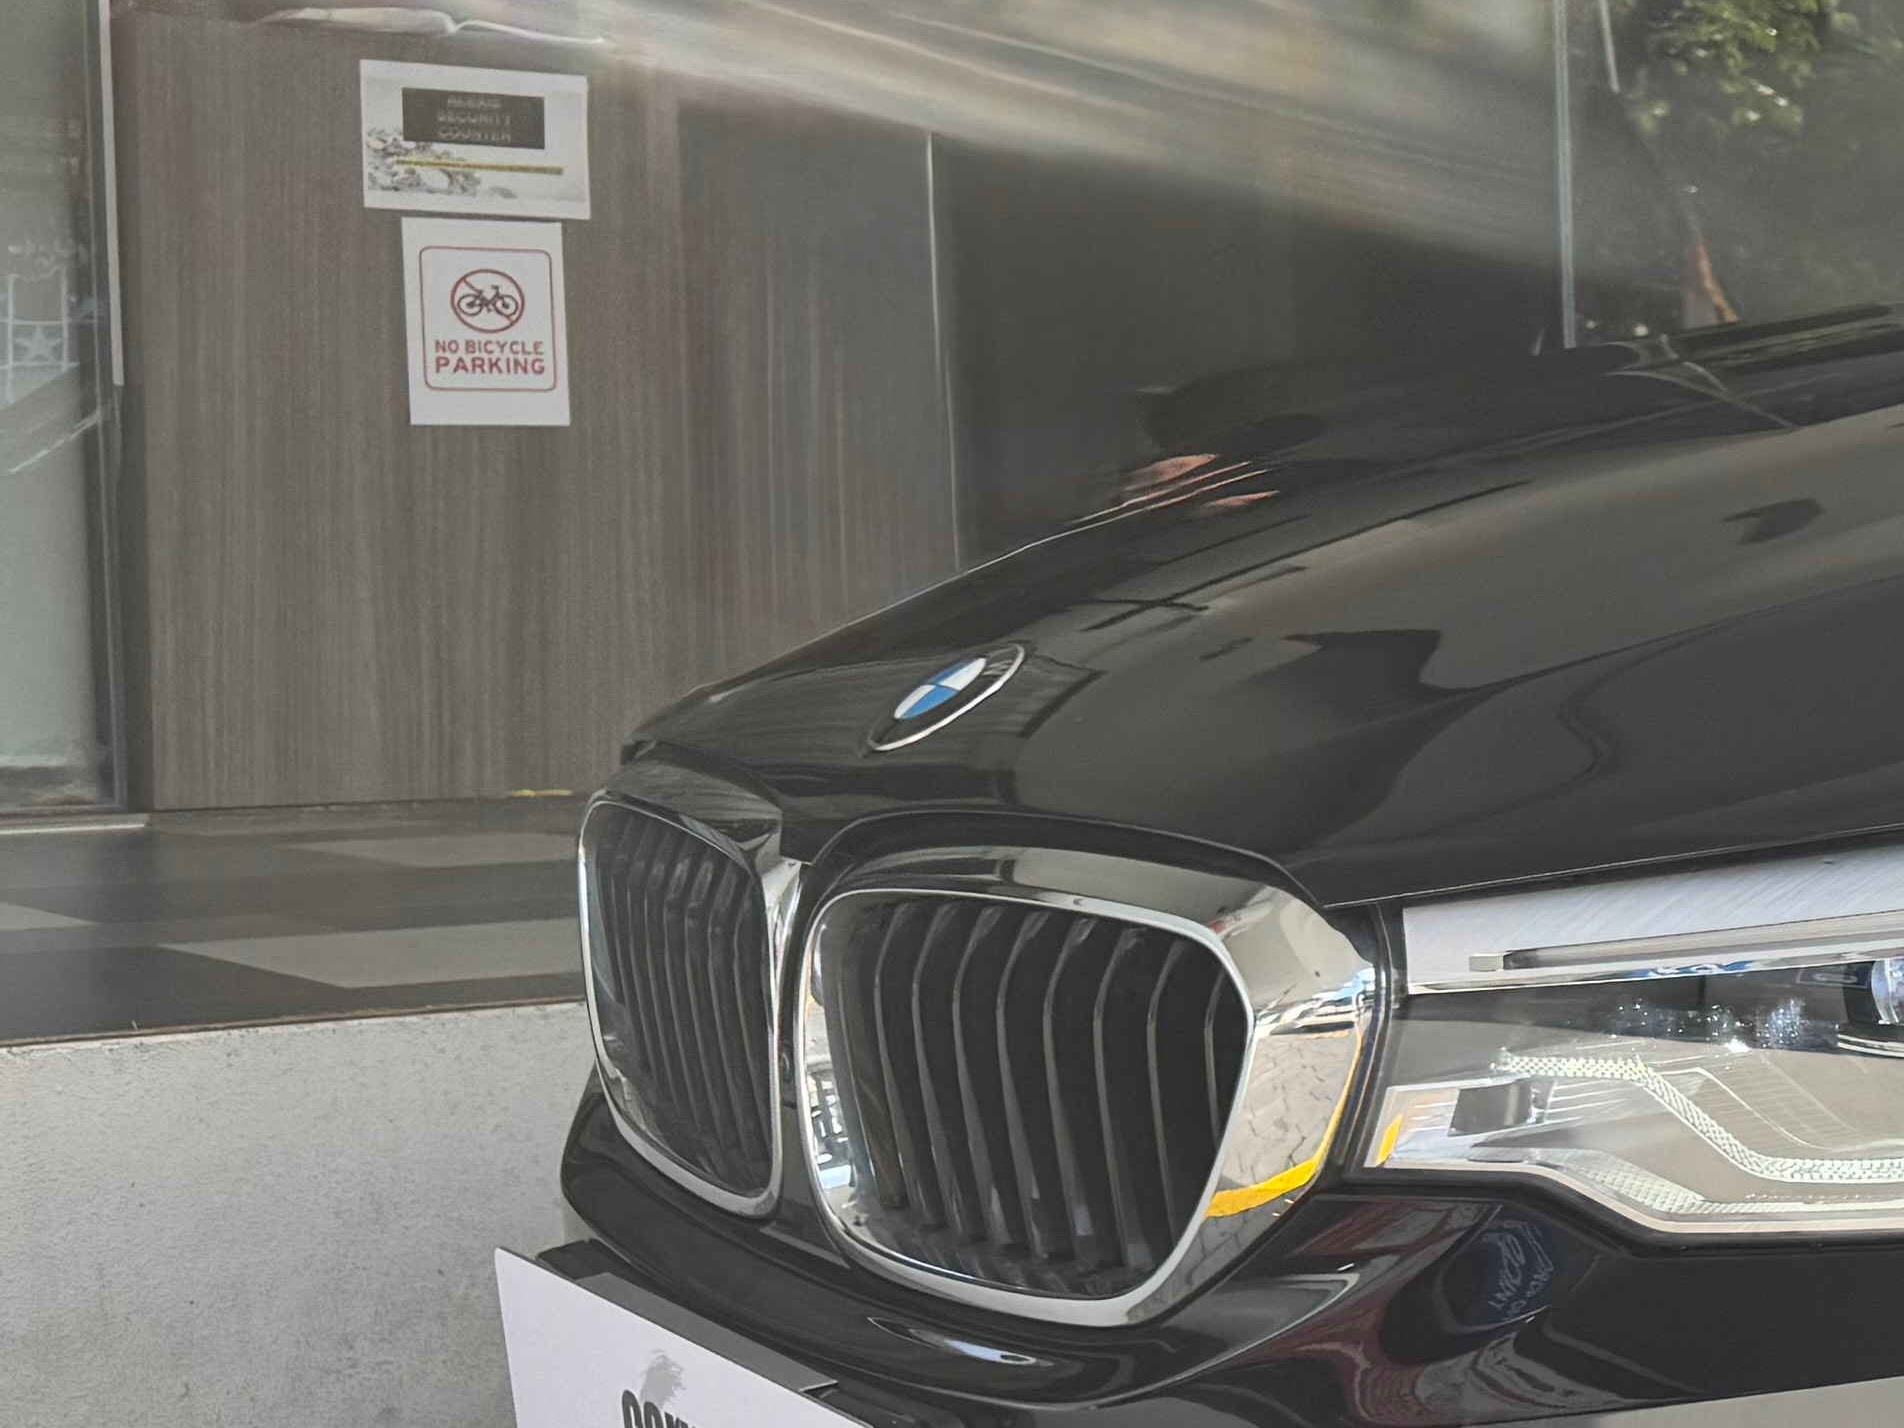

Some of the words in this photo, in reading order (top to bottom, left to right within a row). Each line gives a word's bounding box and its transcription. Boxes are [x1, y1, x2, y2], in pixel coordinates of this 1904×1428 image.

[435, 339, 459, 354] NO
[464, 340, 545, 356] BICYCLE
[435, 356, 546, 375] PARKING
